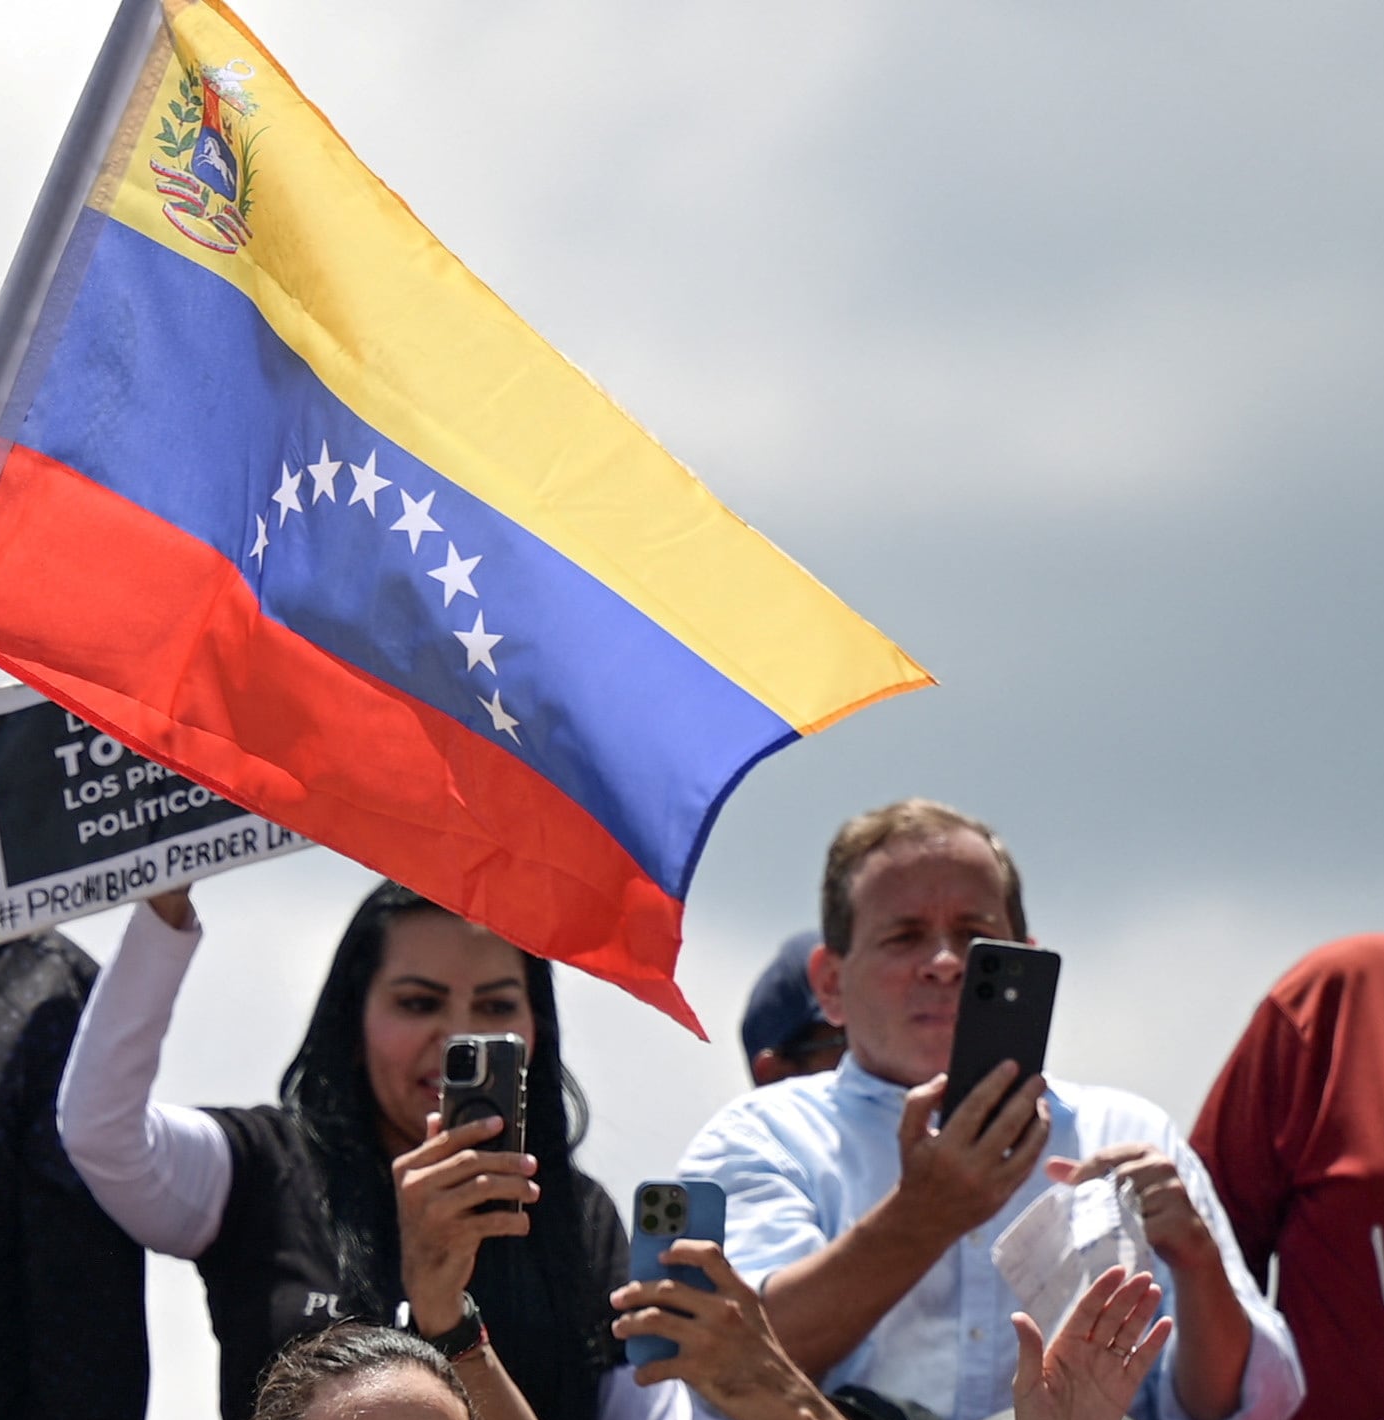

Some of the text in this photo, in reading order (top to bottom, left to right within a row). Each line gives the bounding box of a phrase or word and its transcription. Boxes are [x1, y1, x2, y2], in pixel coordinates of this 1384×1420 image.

[54, 734, 139, 777] TO
[64, 774, 121, 810] LOS
[167, 828, 257, 878] PERDER
